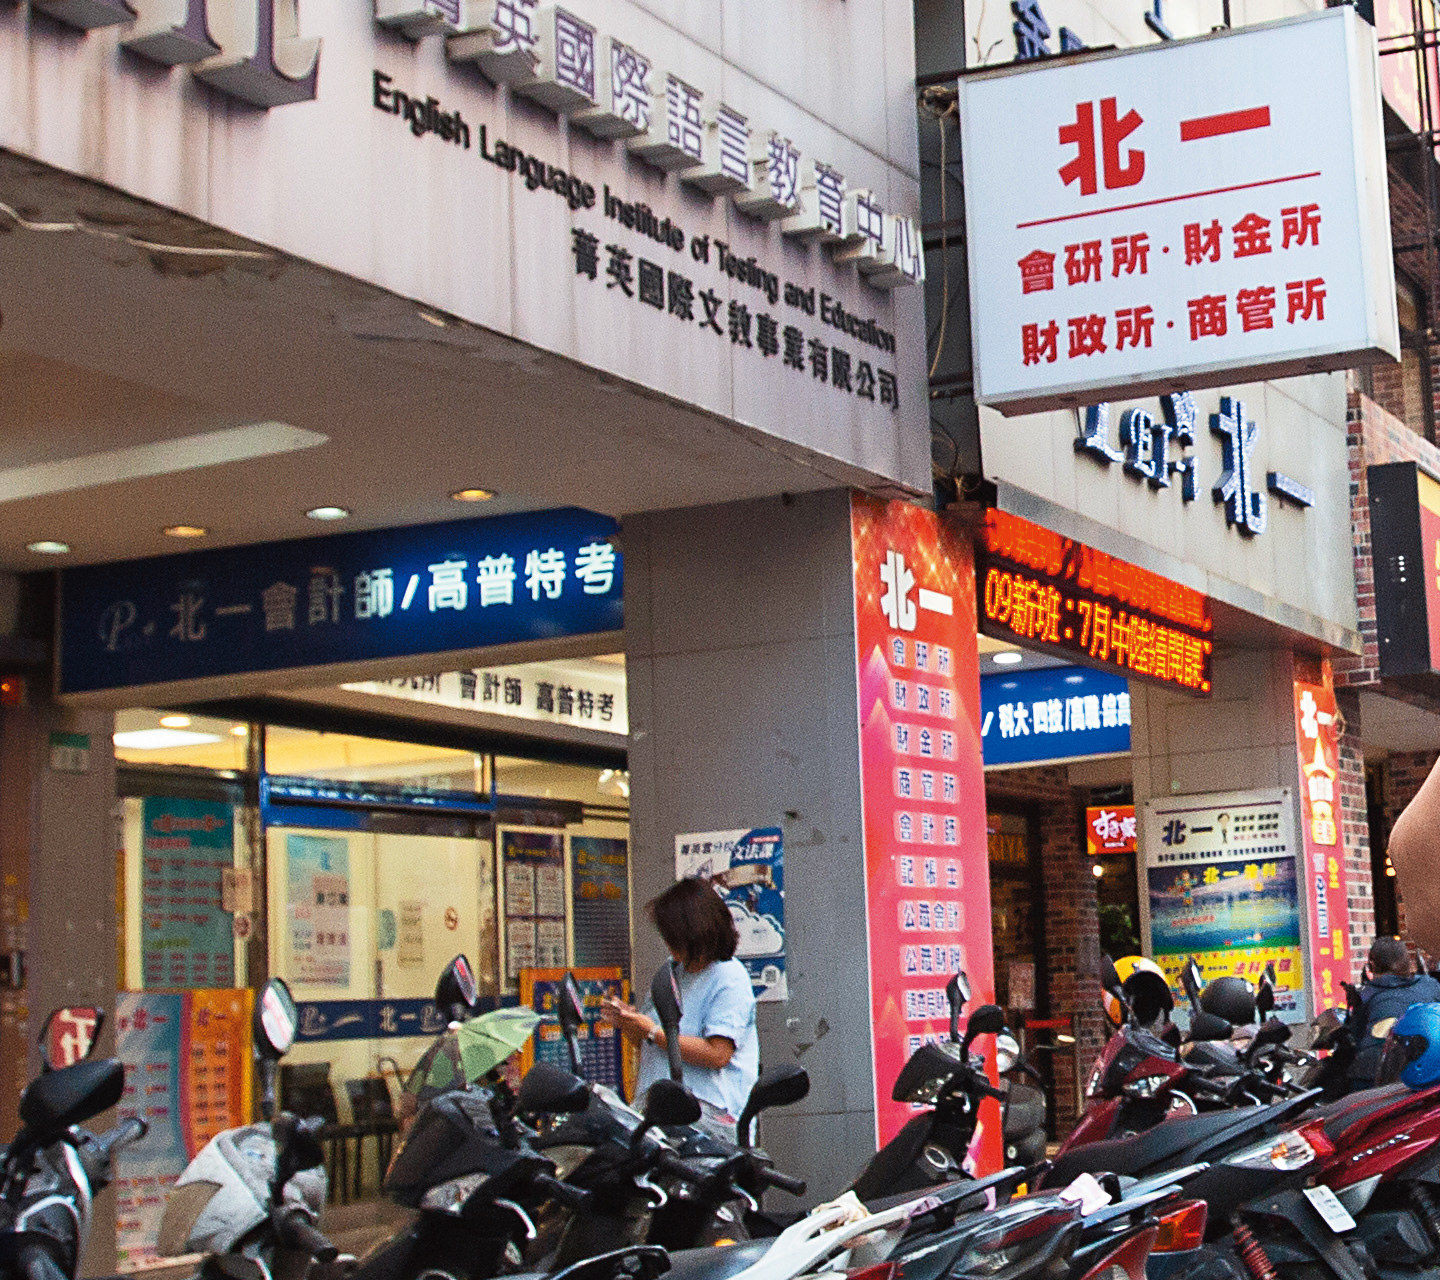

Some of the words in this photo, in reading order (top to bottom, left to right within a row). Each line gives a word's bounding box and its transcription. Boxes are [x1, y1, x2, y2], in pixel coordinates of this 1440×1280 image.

[1059, 96, 1271, 197] 北一
[371, 69, 471, 150] English
[479, 123, 596, 211] Language
[603, 183, 686, 253] Institute
[690, 230, 712, 265] of
[713, 238, 779, 308] Testing
[784, 280, 816, 318] and
[819, 291, 897, 354] Education
[1209, 396, 1316, 537] 北一
[879, 549, 954, 632] 北一
[536, 681, 615, 722] 高普特考
[1162, 819, 1213, 846] 北一
